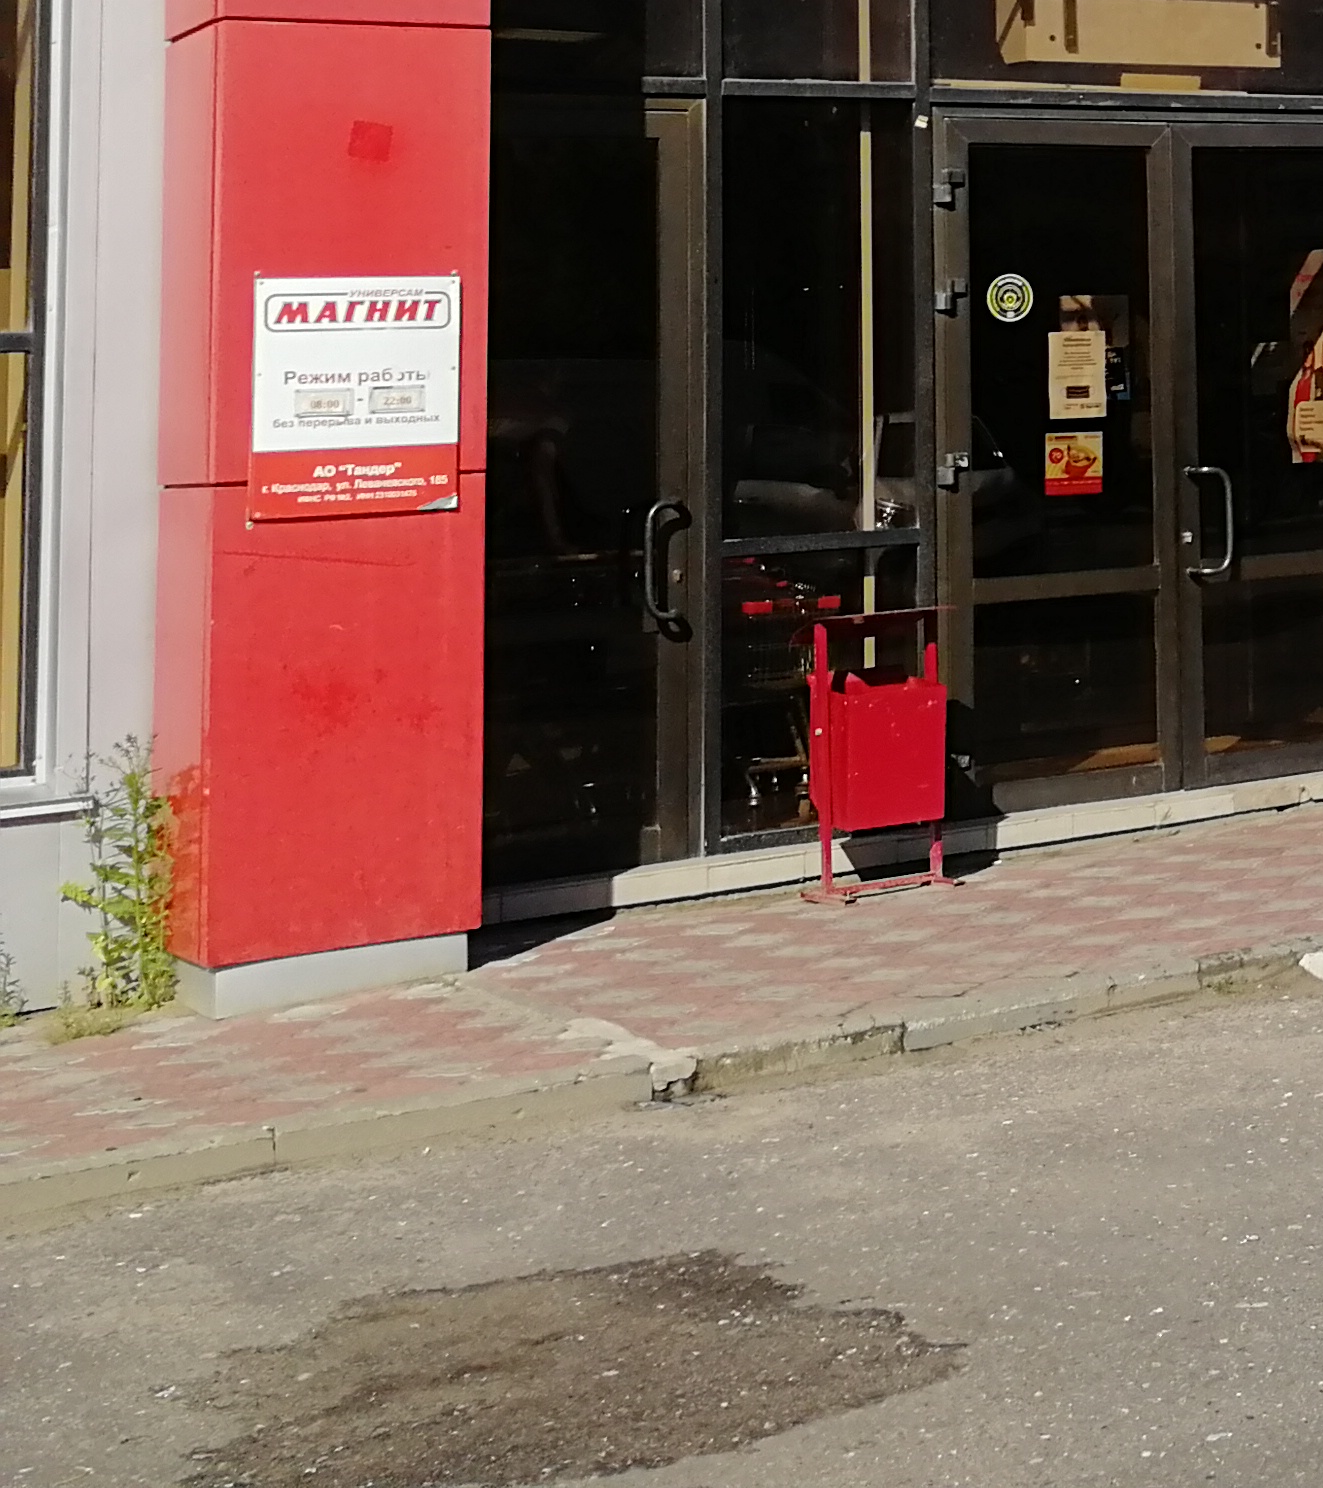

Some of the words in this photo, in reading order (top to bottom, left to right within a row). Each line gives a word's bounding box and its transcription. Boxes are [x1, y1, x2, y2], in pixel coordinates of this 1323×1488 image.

[348, 288, 424, 298] УНИВЕРСАМ
[274, 299, 443, 324] МАГНИТ
[284, 370, 351, 385] Режим
[272, 418, 294, 429] без
[364, 417, 372, 425] и
[376, 414, 440, 425] выходных
[312, 465, 336, 478] АО
